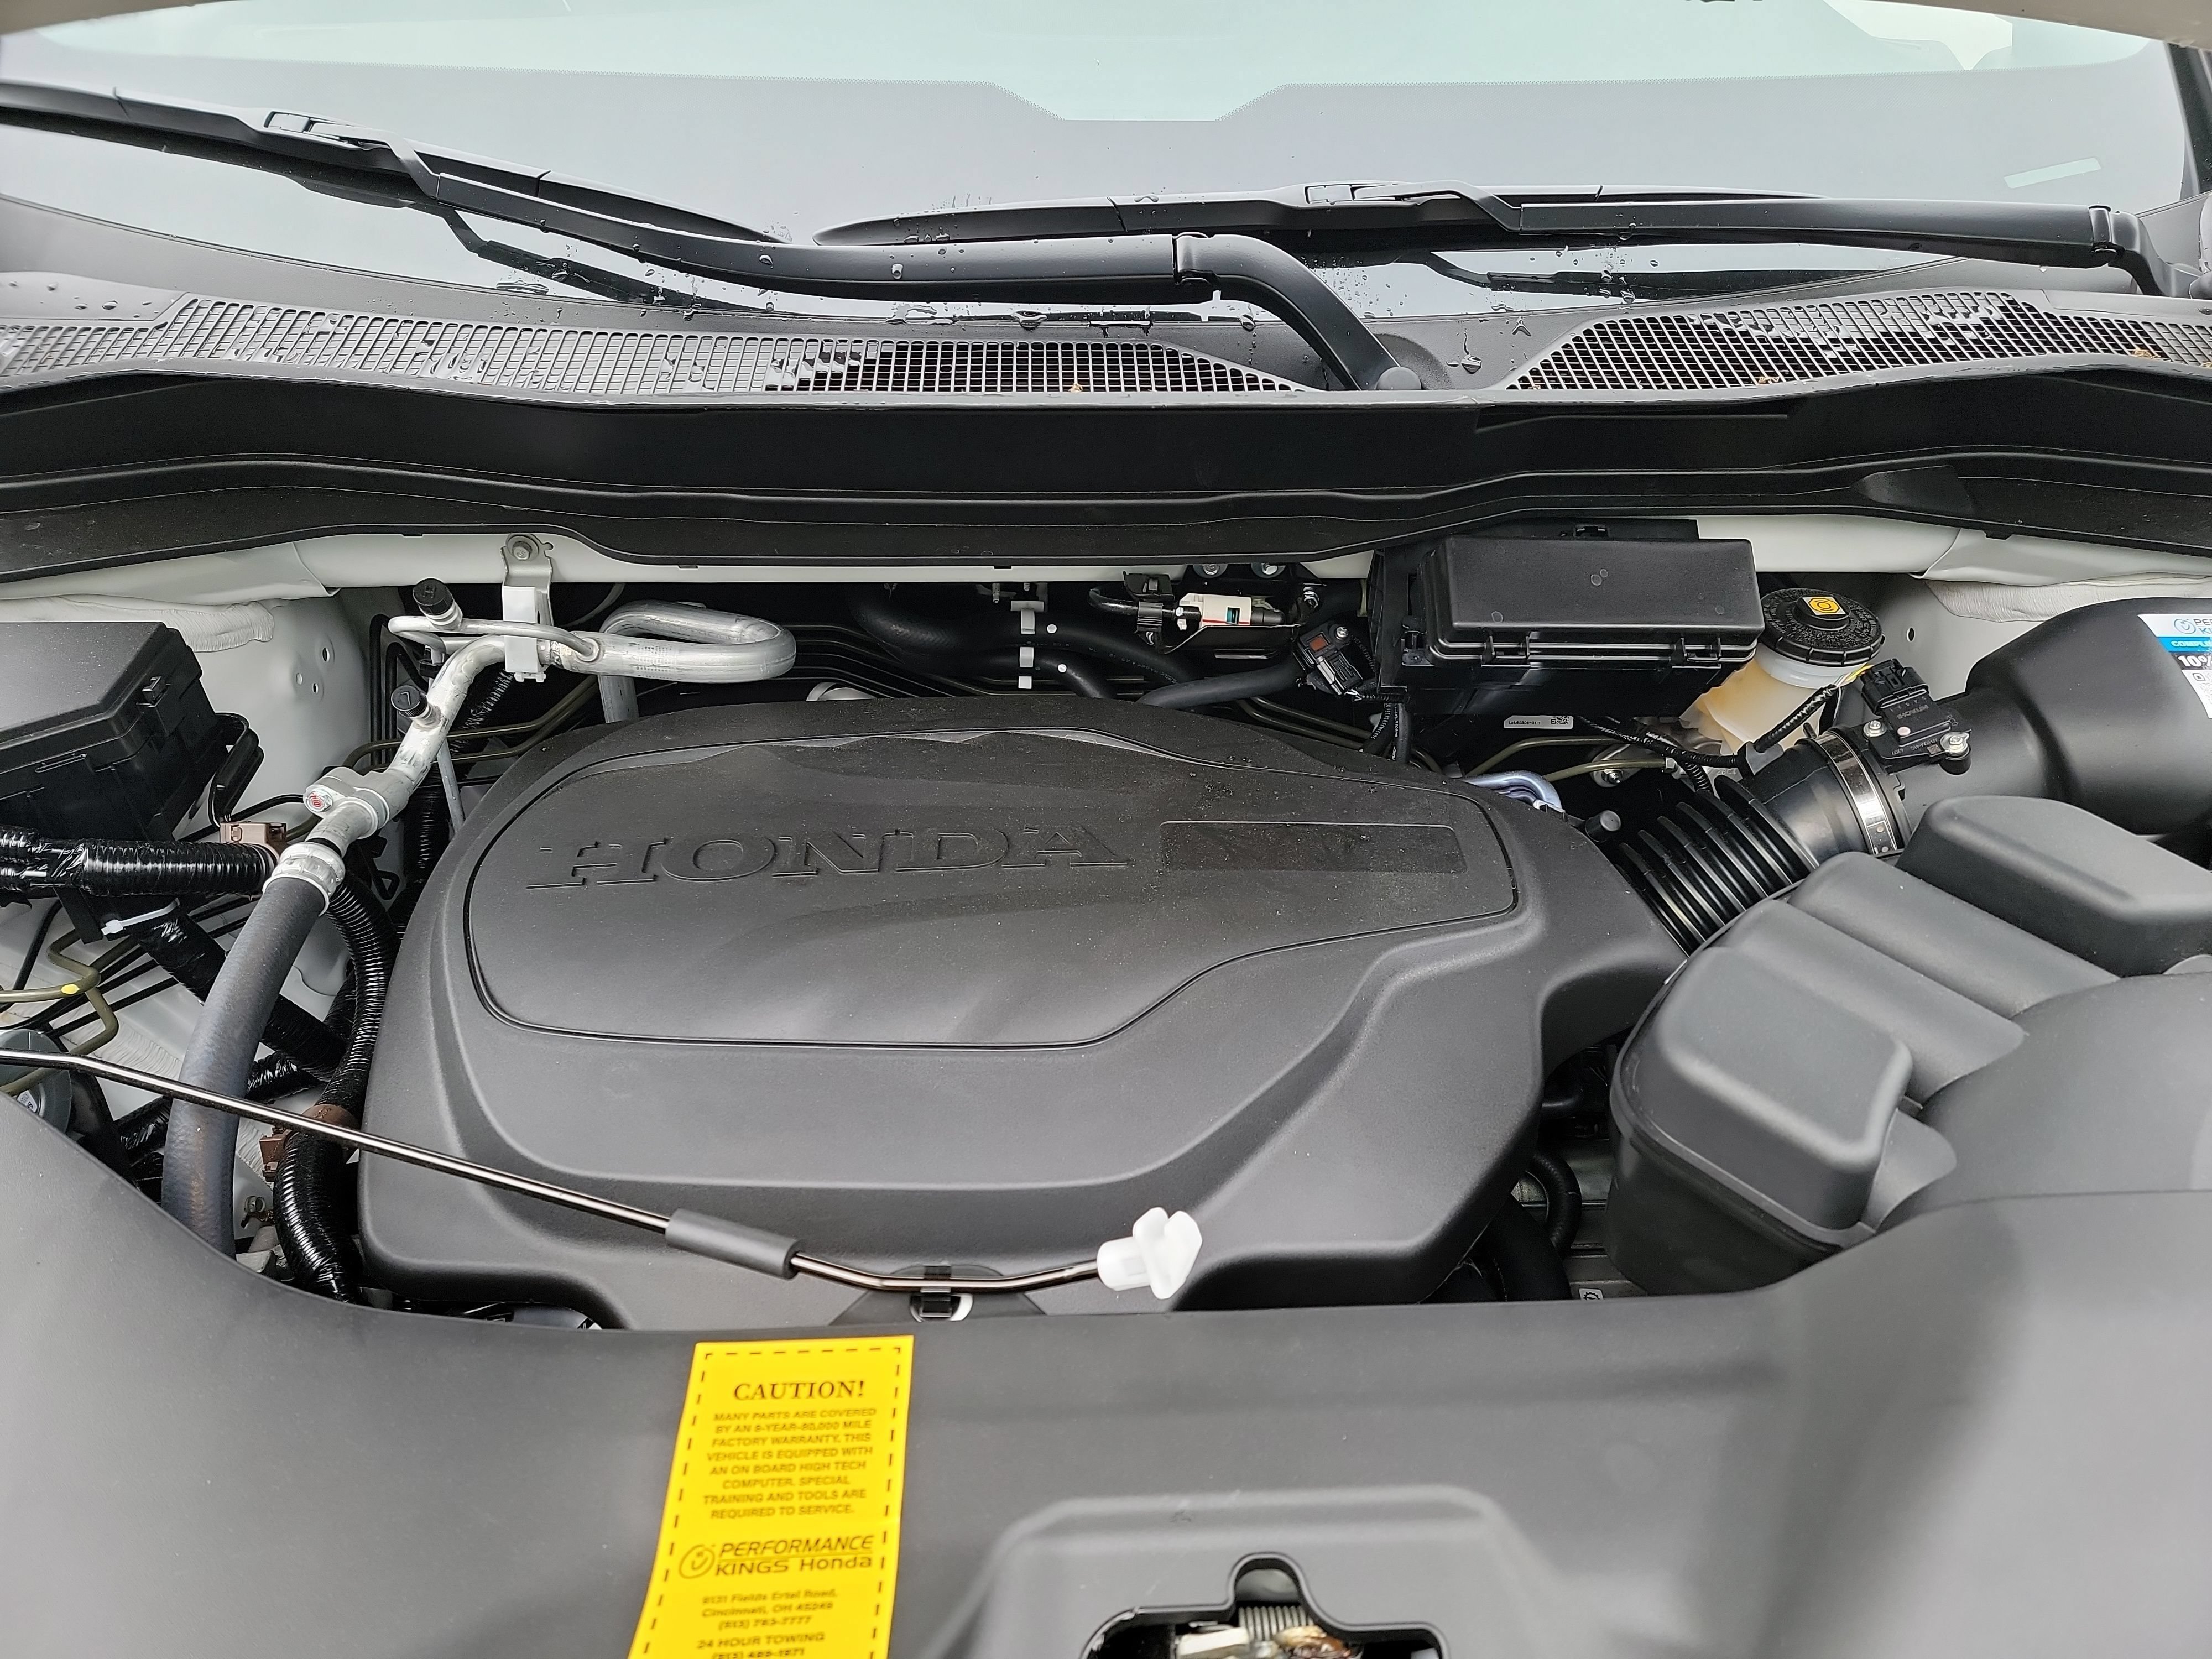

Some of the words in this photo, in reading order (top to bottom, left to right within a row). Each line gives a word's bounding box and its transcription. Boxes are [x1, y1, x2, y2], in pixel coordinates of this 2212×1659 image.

[423, 585, 435, 599] H
[1896, 704, 1929, 720] HITACHI
[526, 825, 1128, 890] HONDA
[734, 1380, 864, 1401] CAUTION!
[713, 1412, 750, 1422] MANY
[753, 1411, 790, 1421] PARTS
[793, 1410, 817, 1420] ARE
[820, 1408, 877, 1418] COVERED
[715, 1425, 732, 1434] BY
[734, 1424, 751, 1433] AN
[842, 1420, 872, 1430] MILE
[712, 1437, 768, 1448] FACTORY
[845, 1433, 872, 1443] THIS
[707, 1449, 759, 1461] VEHICLE
[761, 1450, 774, 1459] IS
[776, 1447, 839, 1459] EQUIPPED
[841, 1446, 873, 1456] WITH
[709, 1466, 728, 1475] AN
[731, 1465, 750, 1475] ON
[753, 1463, 797, 1474] BOARD
[799, 1462, 831, 1473] HIGH
[834, 1460, 867, 1471] TECH
[799, 1475, 851, 1486] SPECIAL
[703, 1493, 764, 1505] TRAINING
[766, 1492, 795, 1502] AND
[798, 1490, 839, 1501] TOOLS
[841, 1489, 867, 1499] ARE
[711, 1507, 775, 1520] REQUIRED
[779, 1506, 796, 1516] TO
[721, 1535, 873, 1556] PERFORMANCE
[716, 1559, 789, 1577] KINGS
[800, 1556, 872, 1572] Honda
[773, 1605, 793, 1613] OH
[697, 1639, 714, 1650] 24
[717, 1636, 761, 1647] HOUR
[765, 1631, 826, 1645] TOWING
